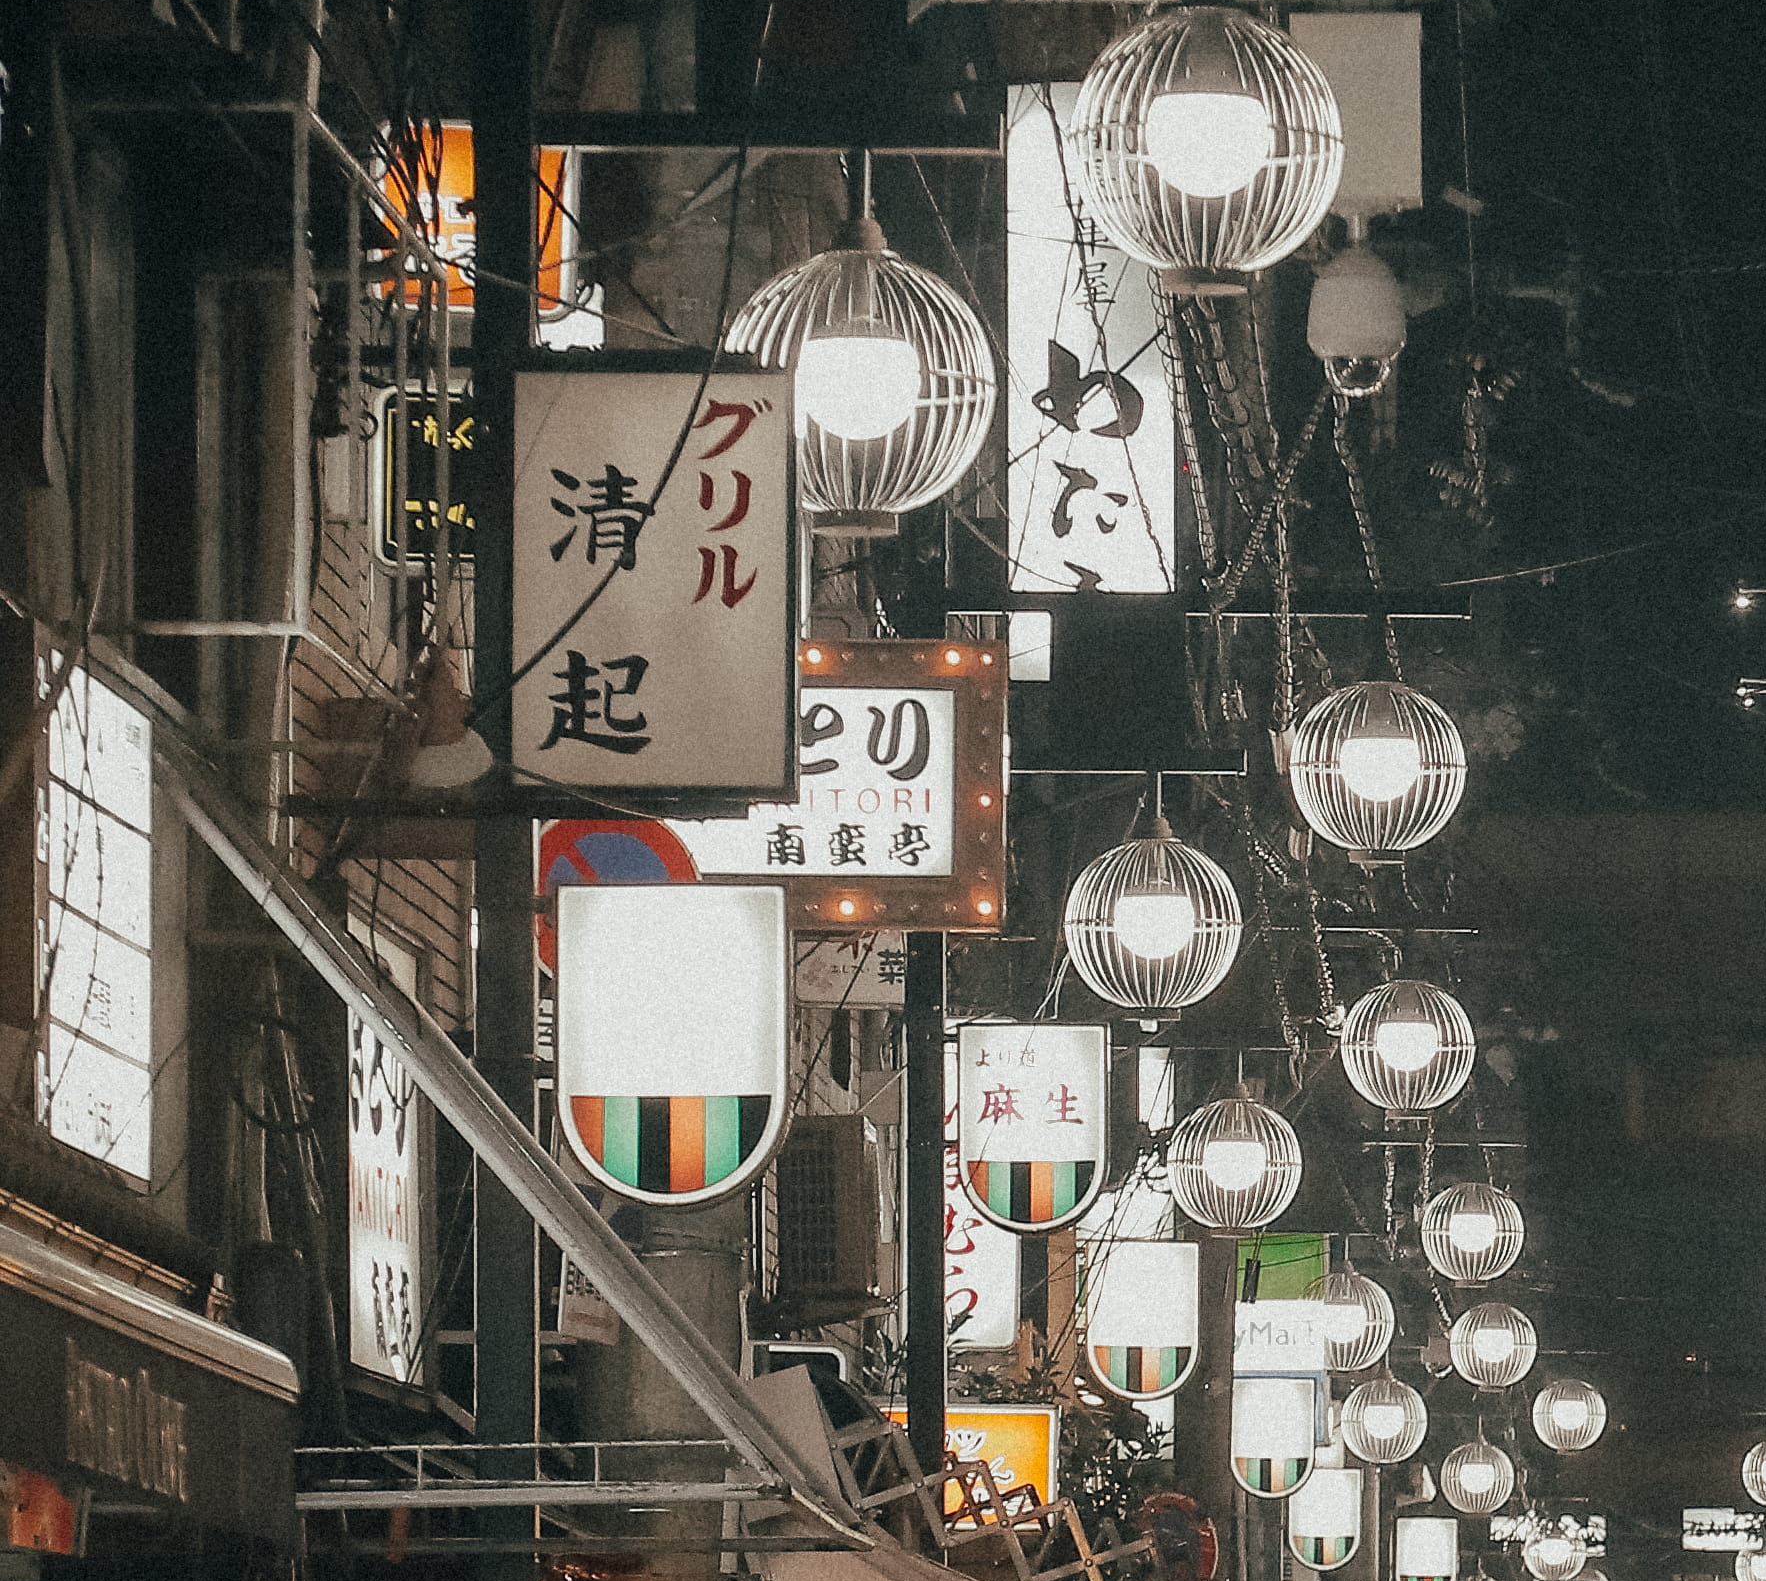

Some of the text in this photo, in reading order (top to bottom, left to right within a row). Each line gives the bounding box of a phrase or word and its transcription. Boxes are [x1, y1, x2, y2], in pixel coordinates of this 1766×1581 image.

[692, 396, 774, 610] グリル
[538, 464, 654, 756] 清起
[748, 787, 931, 815] ITORI
[975, 1082, 1084, 1126] 麻生
